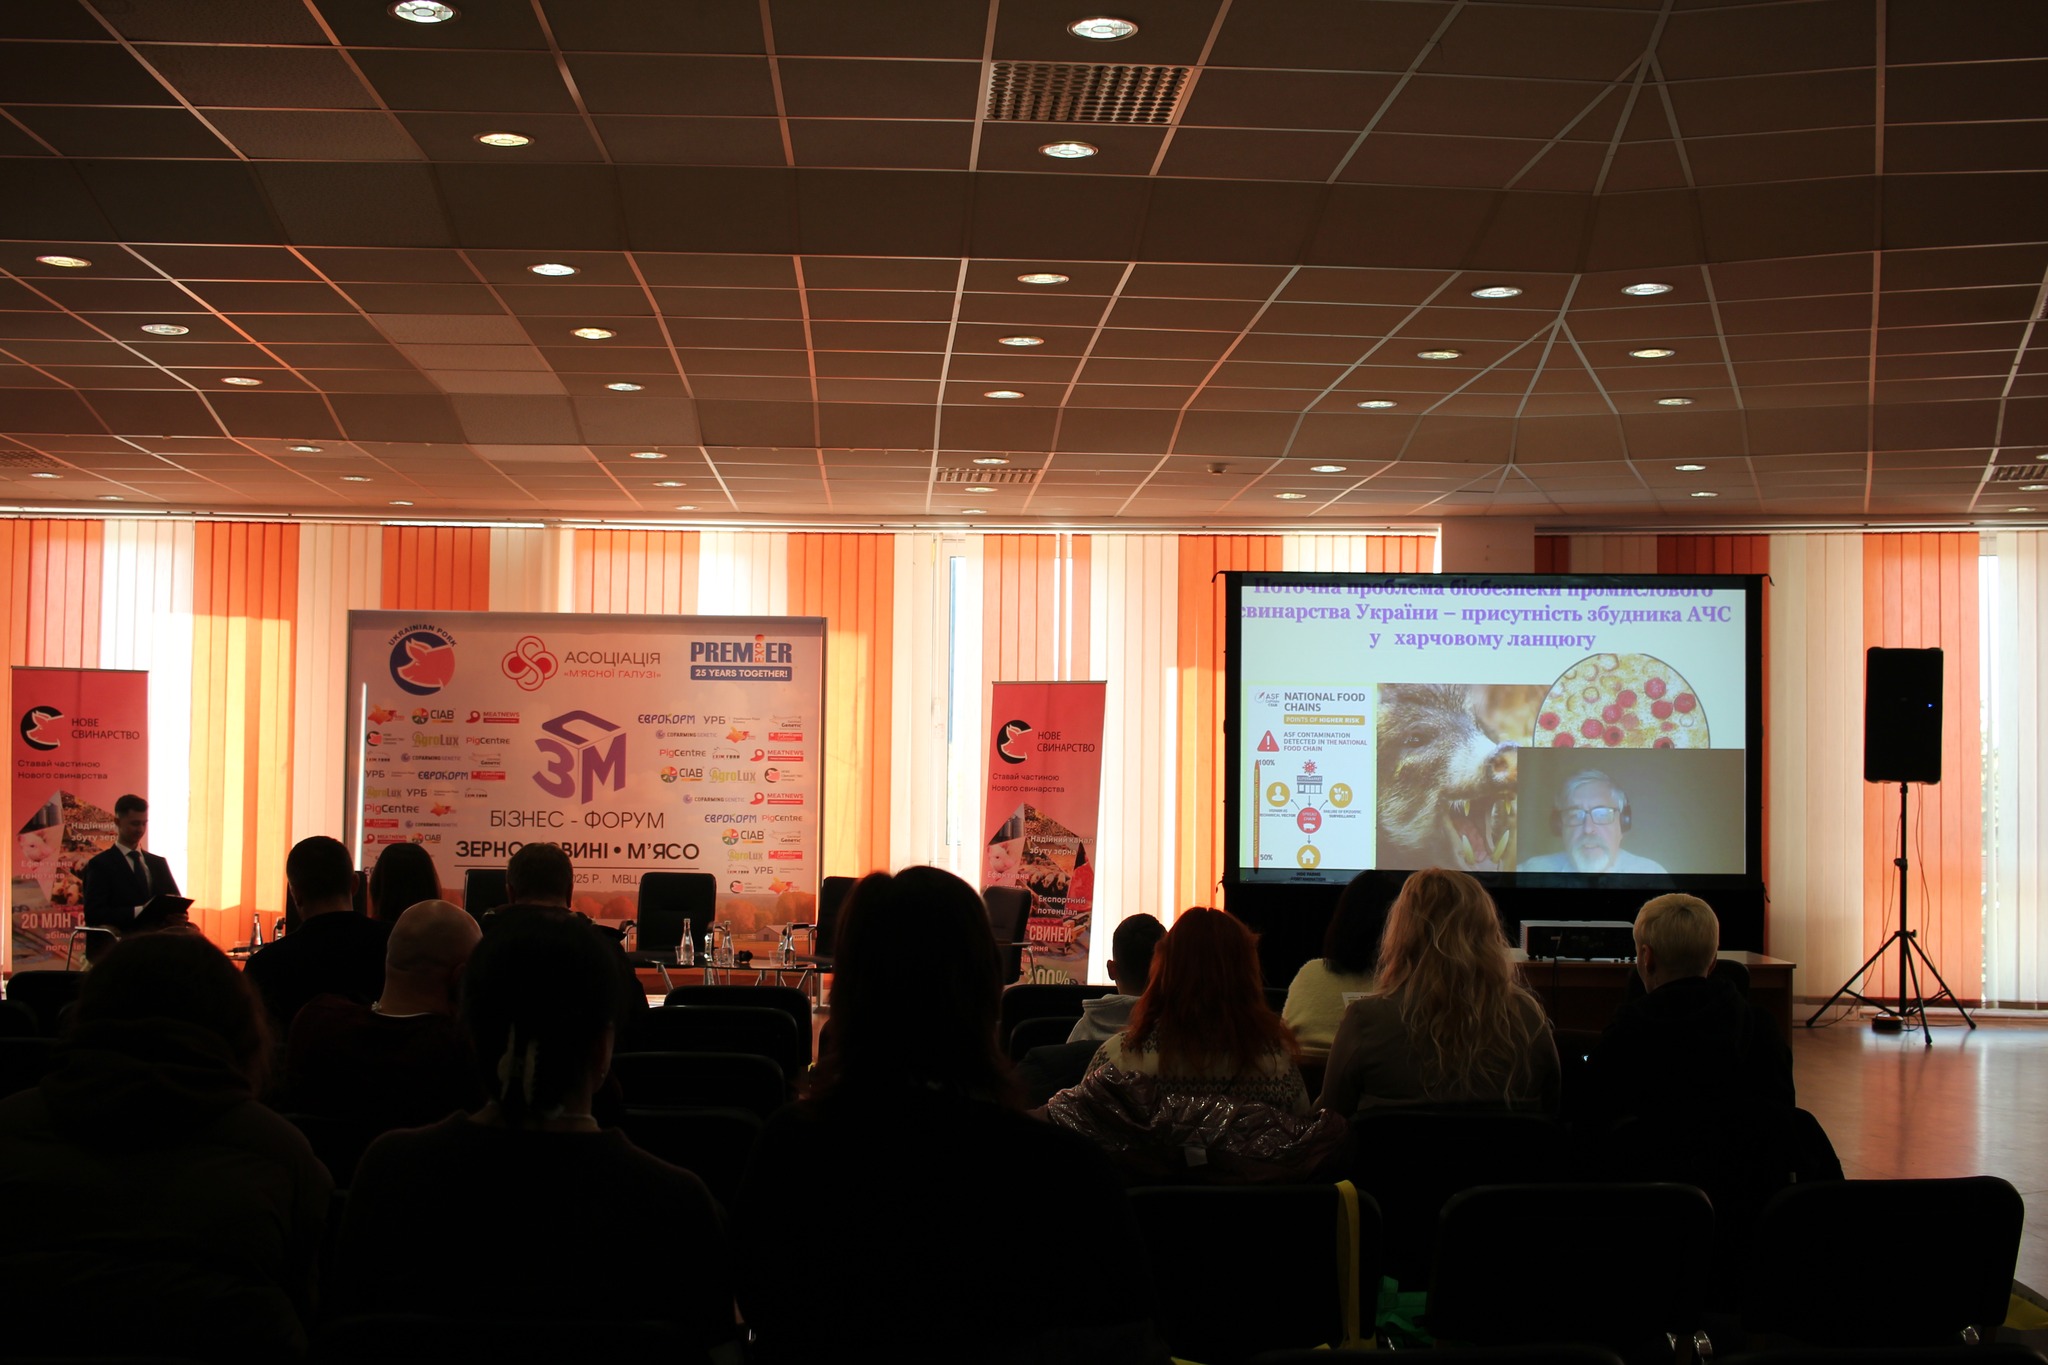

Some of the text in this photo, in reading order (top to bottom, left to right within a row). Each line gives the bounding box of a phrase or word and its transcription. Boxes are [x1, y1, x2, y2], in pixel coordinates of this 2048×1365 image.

[1253, 578, 1713, 600] Поточна проблема біобезпеки промислового
[1355, 603, 1438, 624] України
[1461, 605, 1583, 625] присутність
[1587, 605, 1682, 625] збудника
[1686, 605, 1732, 622] АЧС
[388, 624, 457, 647] UKRAINIAN PORK
[1370, 632, 1596, 650] у харчовому ланцюгу
[564, 651, 661, 667] АСОЦІАЦІЯ
[695, 669, 788, 678] 25 YEARS TOGETHER!
[1284, 692, 1366, 702] NATIONAL FOOD
[1284, 703, 1321, 712] CHAINS
[430, 709, 454, 719] CIAB
[638, 714, 695, 724] ЄВРОКОРМ
[71, 718, 99, 727] НОВЕ
[703, 716, 726, 724] УРБ
[71, 730, 140, 740] СВИНАРСТВО
[412, 733, 459, 747] AgroLux
[1037, 731, 1061, 741] НОВЕ
[1037, 743, 1095, 753] СВИНАРСТВО
[18, 759, 100, 768] Ставай частиною
[18, 771, 108, 780] Нового свинарства
[366, 770, 385, 778] УРБ
[418, 771, 468, 780] ЄВРОКОРМ
[679, 768, 703, 777] CIAB
[711, 770, 756, 783] AgroLux
[992, 773, 1019, 781] Ставай
[406, 789, 427, 797] УРБ
[992, 784, 1018, 792] Нового
[490, 810, 564, 828] БІЗНЕС
[584, 811, 665, 829] ФОРУМ
[704, 813, 757, 823] ЄВРОКОРМ
[740, 830, 764, 840] CIAB
[628, 843, 700, 860] М’ЯСО
[1029, 847, 1052, 856] збуту
[754, 867, 774, 875] УРБ
[1038, 894, 1086, 904] Експортний
[1037, 907, 1078, 917] потенціал
[21, 914, 38, 929] 20
[41, 913, 71, 929] МЛН
[1029, 923, 1072, 943] СВИНЕЙ
